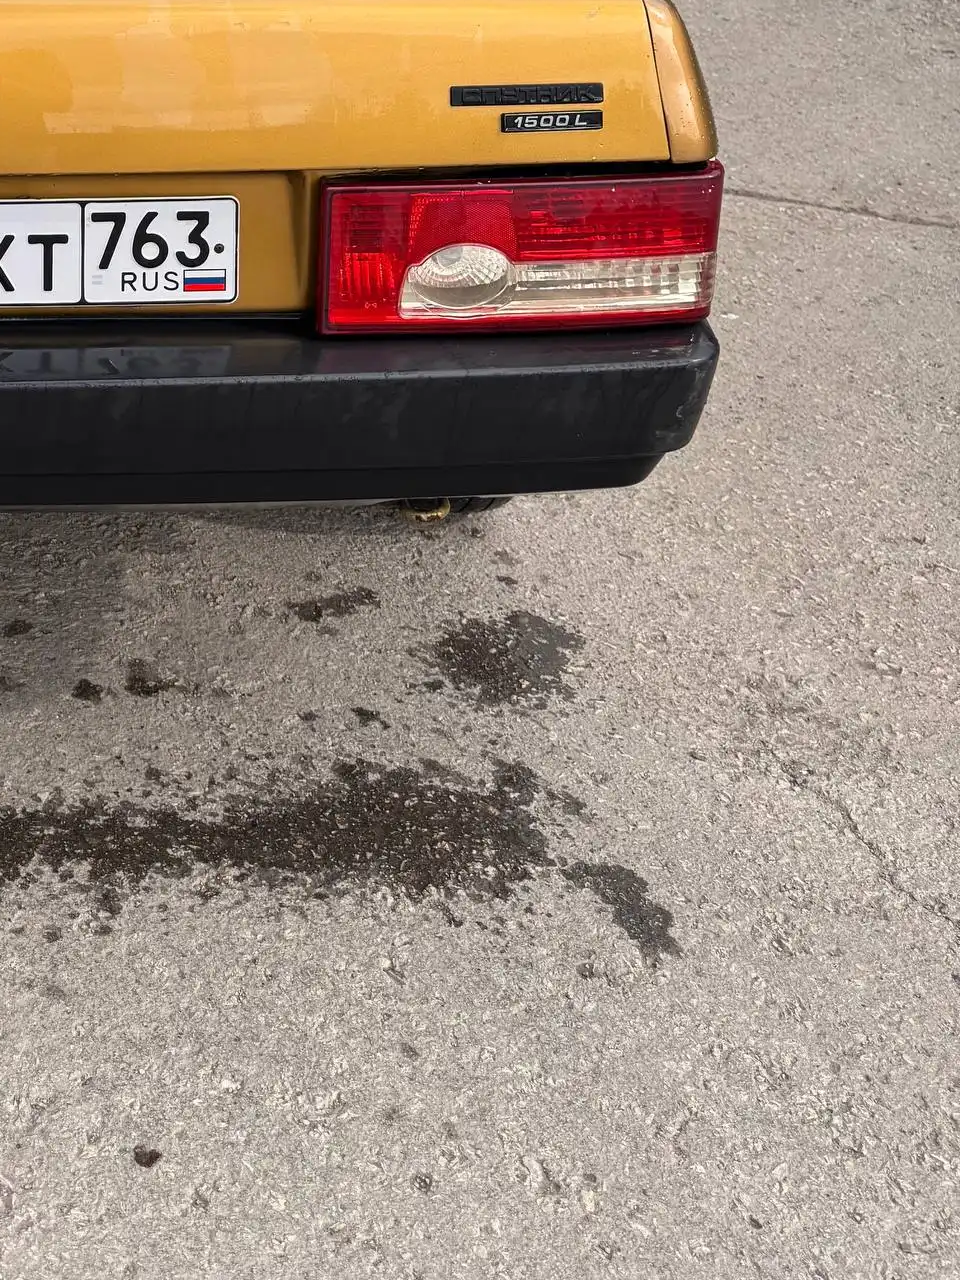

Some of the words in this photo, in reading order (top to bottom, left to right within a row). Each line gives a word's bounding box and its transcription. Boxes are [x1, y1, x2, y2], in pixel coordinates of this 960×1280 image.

[514, 115, 570, 129] 1500
[90, 211, 210, 269] 763
[120, 271, 179, 291] RUS
